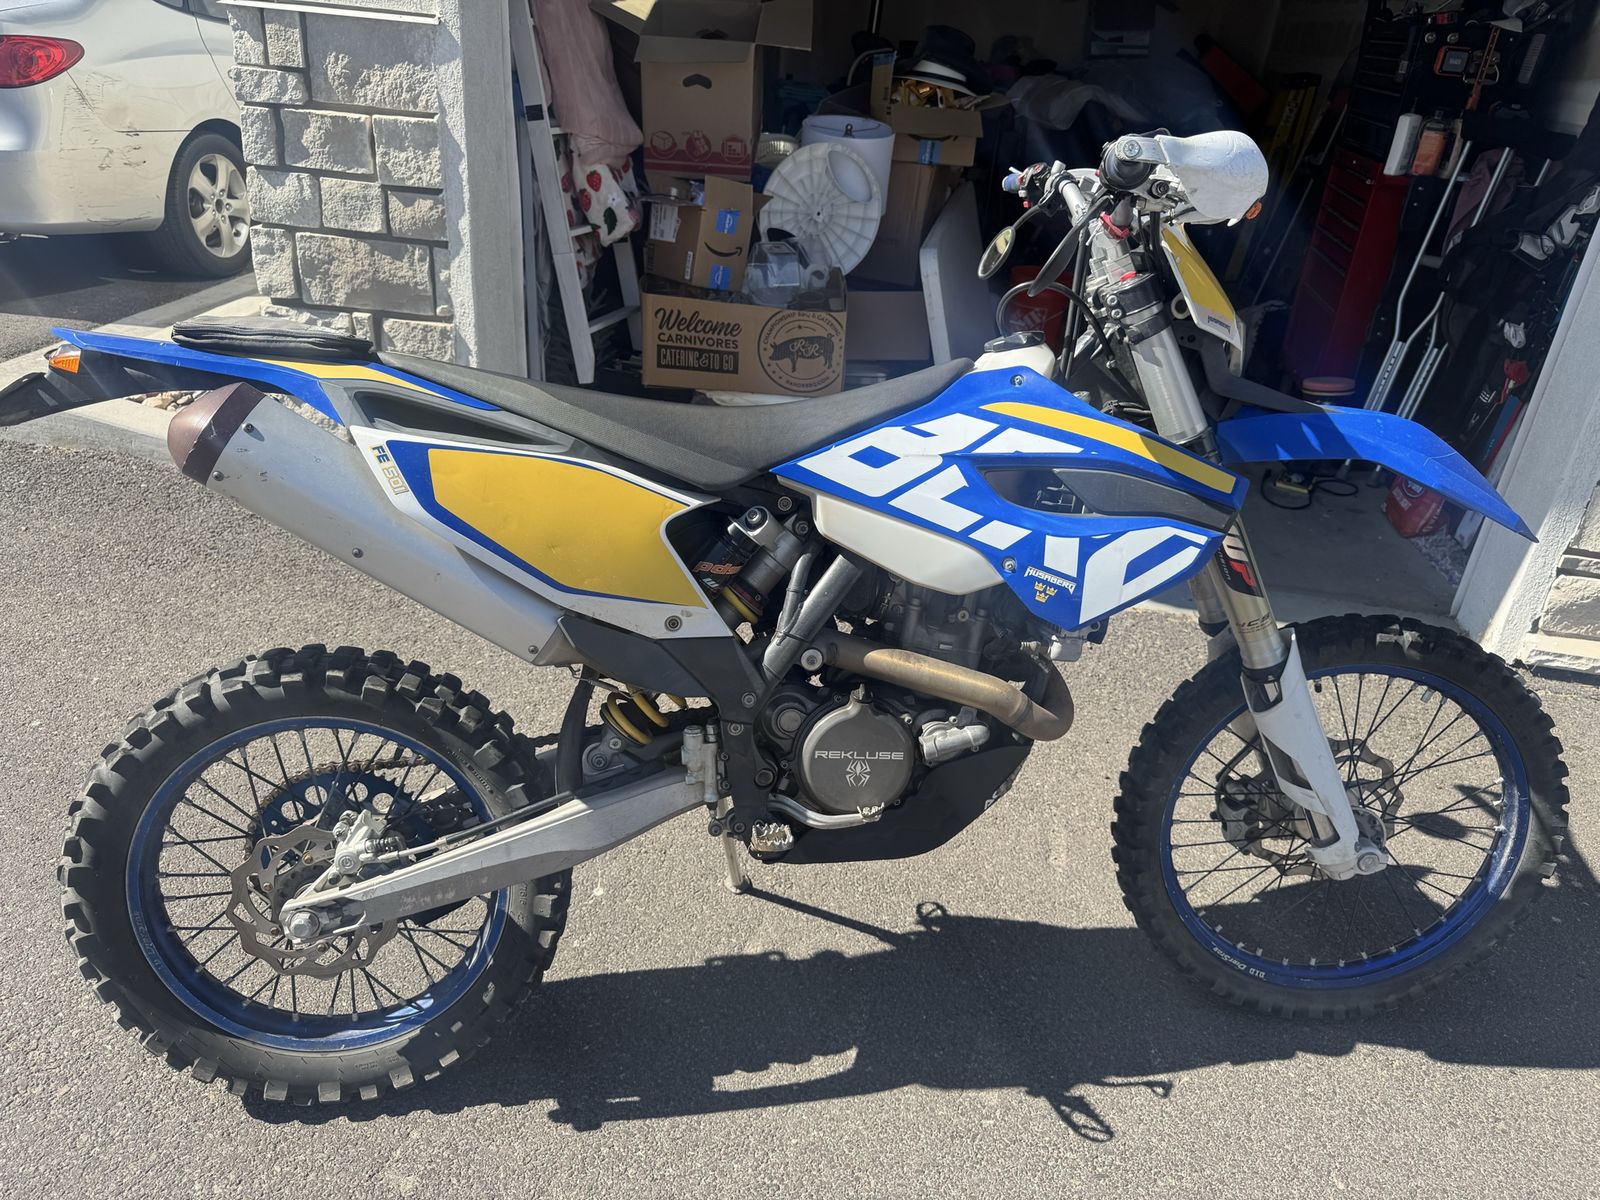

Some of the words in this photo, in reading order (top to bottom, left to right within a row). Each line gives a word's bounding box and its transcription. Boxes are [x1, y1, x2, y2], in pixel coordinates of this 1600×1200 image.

[654, 307, 743, 338] Welcome
[657, 332, 739, 350] CARNIVORES
[660, 347, 700, 368] CATERING
[699, 353, 709, 367] &
[710, 352, 720, 370] TO
[722, 354, 734, 371] GO
[372, 446, 390, 463] FE
[1024, 566, 1077, 595] HUSABERG
[815, 750, 905, 761] REKLUSE
